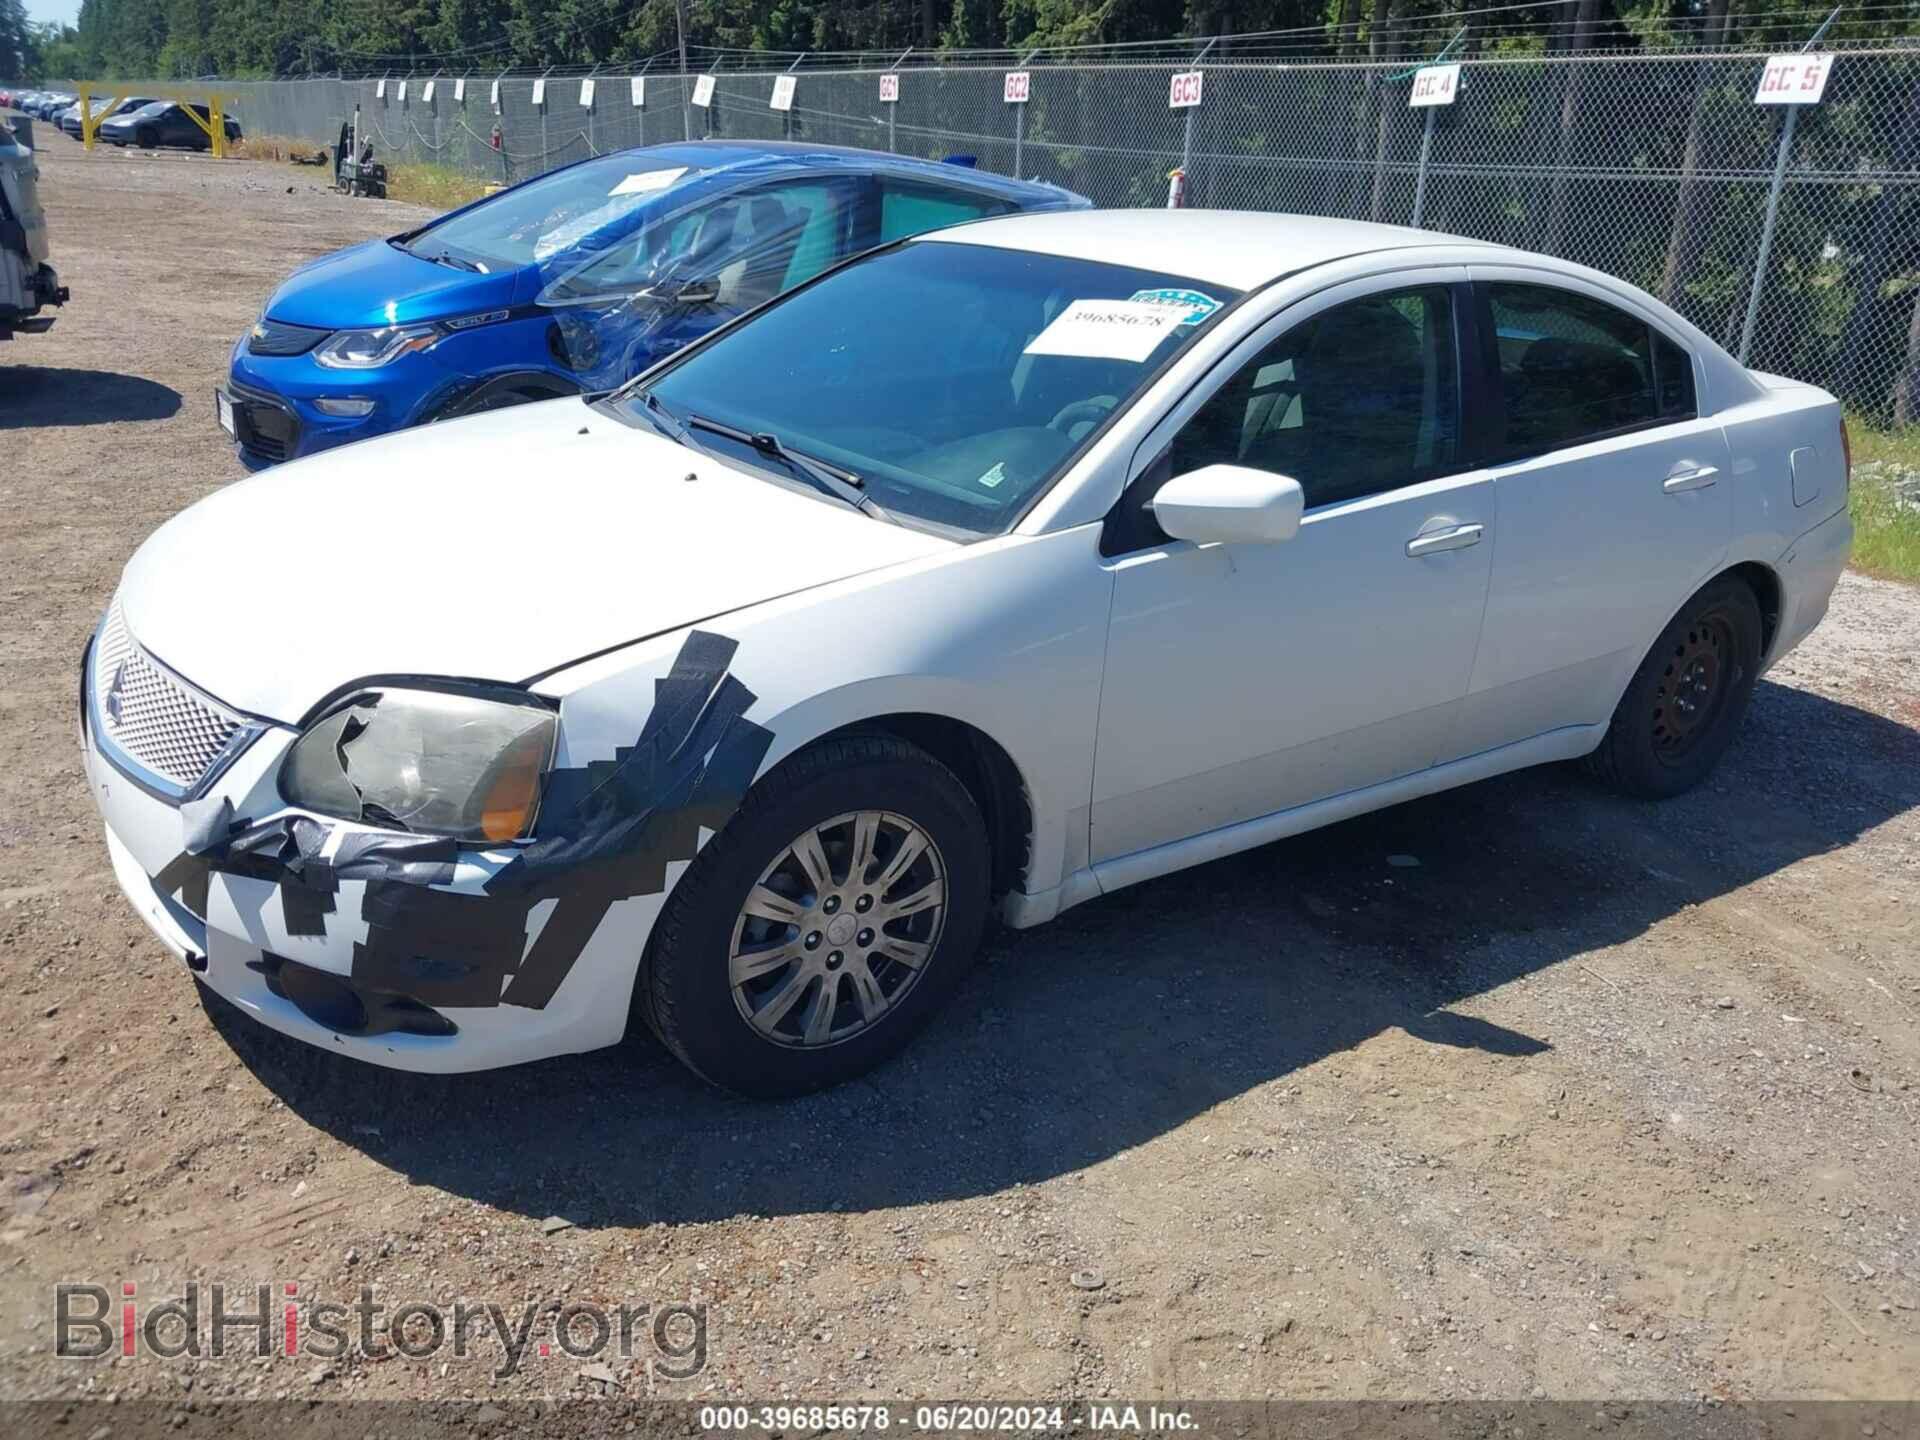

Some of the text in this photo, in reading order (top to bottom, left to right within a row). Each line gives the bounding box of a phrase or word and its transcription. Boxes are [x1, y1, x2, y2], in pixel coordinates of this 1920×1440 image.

[881, 78, 897, 98] GC1
[1006, 76, 1027, 98] GC2
[1173, 76, 1200, 102] GC3
[1415, 73, 1452, 97] GC 4
[1761, 65, 1821, 92] GC 5
